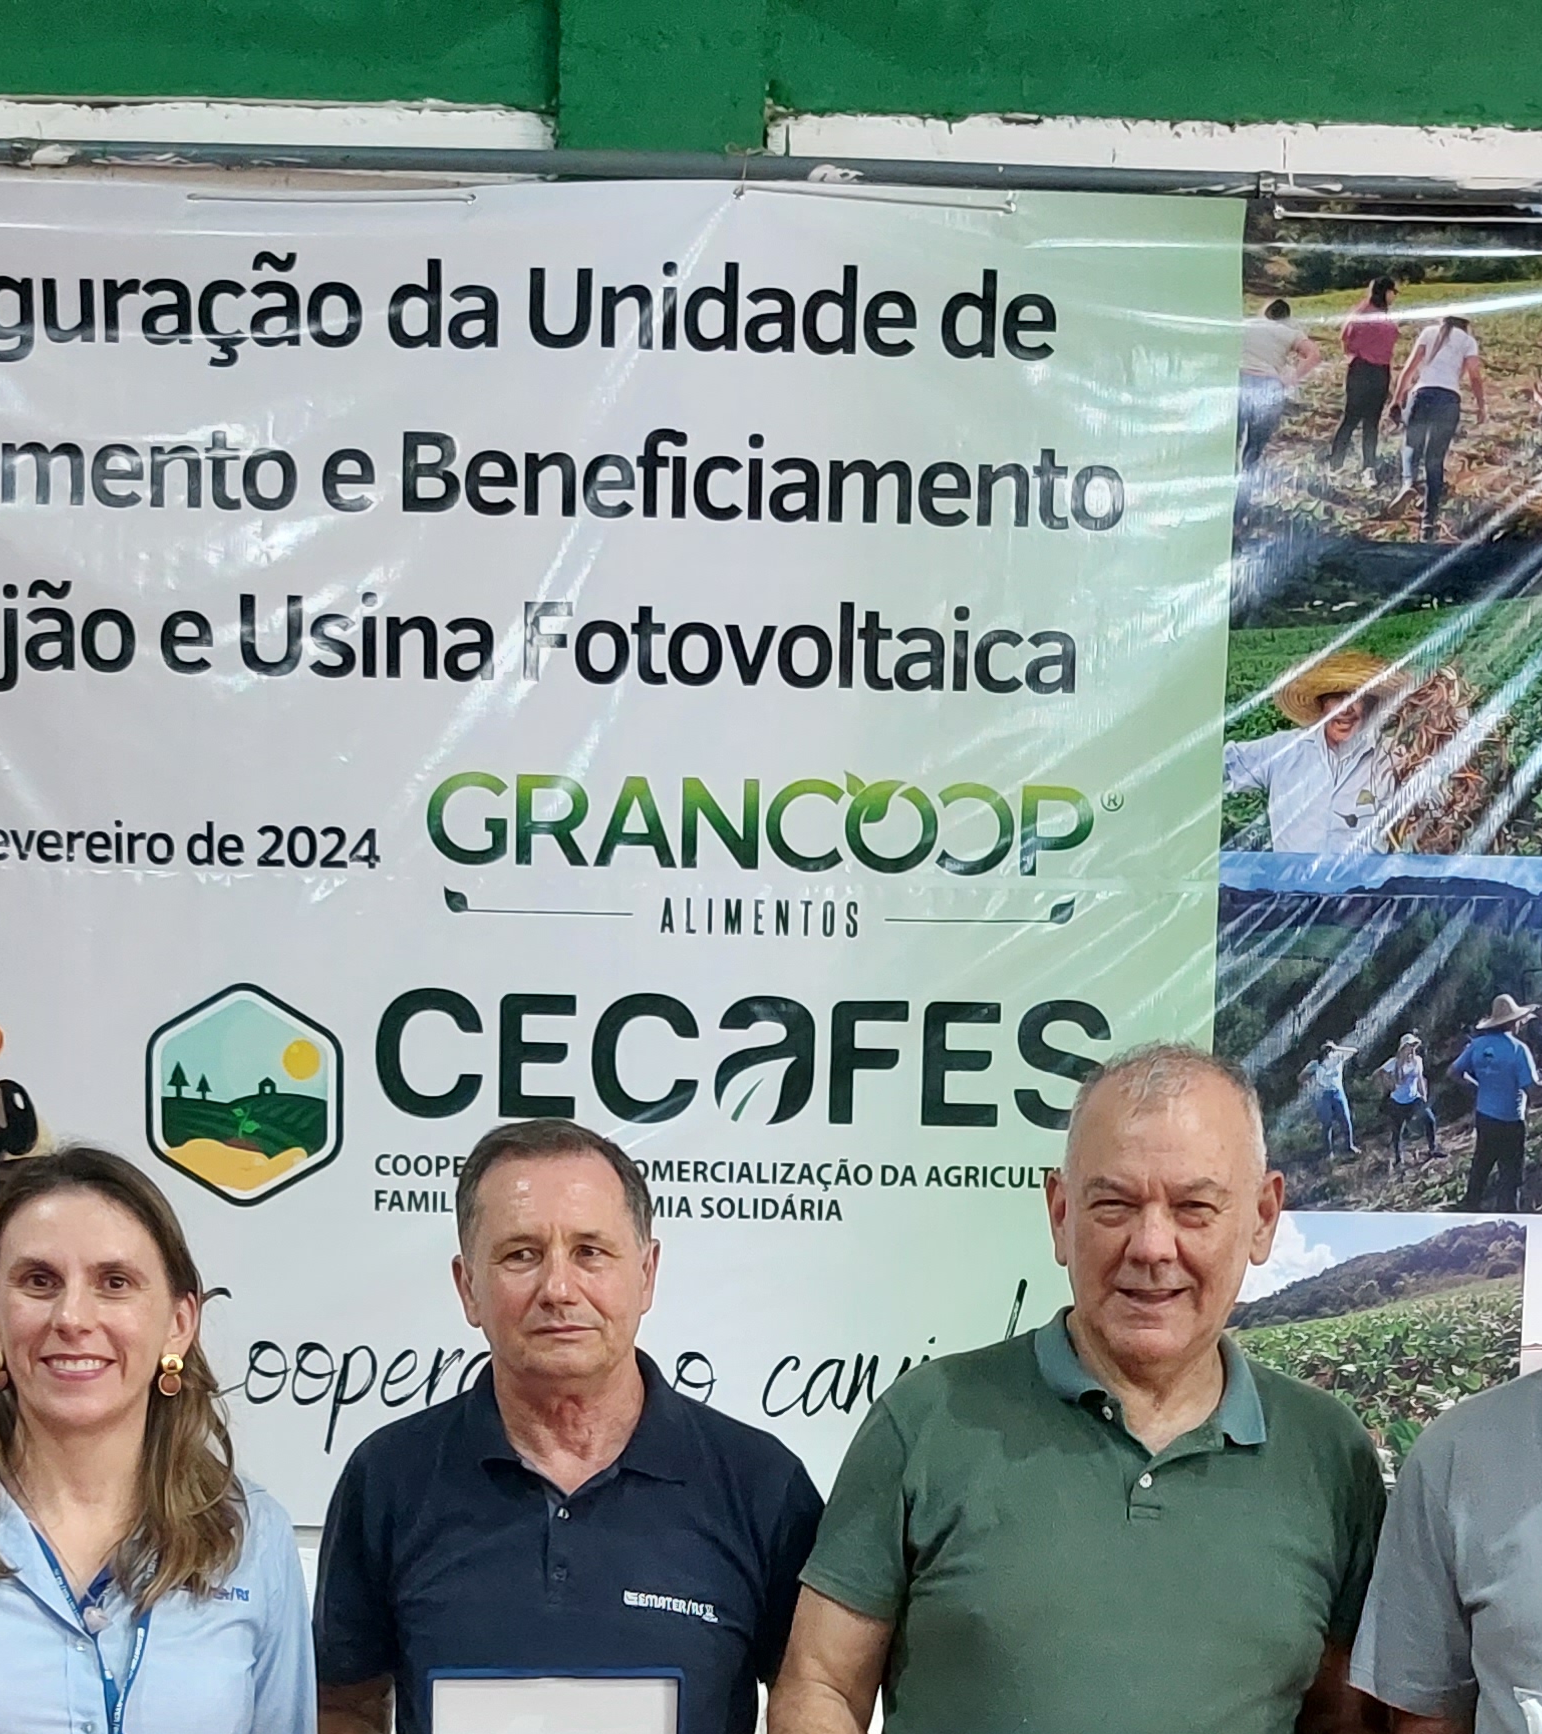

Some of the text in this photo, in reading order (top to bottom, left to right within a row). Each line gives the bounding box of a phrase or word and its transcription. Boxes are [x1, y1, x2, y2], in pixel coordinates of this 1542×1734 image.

[388, 259, 498, 349] da
[529, 261, 915, 355] Unidade
[941, 270, 1056, 360] de
[322, 445, 375, 512] e
[401, 429, 1125, 531] Beneficiamento
[160, 609, 213, 674] e
[239, 592, 495, 681] Usina
[522, 601, 1076, 694] Fotovoltaica
[185, 821, 245, 867] de
[257, 826, 381, 870] 2024
[660, 896, 860, 938] ALIMENTOS
[880, 1165, 917, 1188] DA
[924, 1165, 1061, 1190] AGRICULT
[373, 1189, 454, 1213] FAMIL
[700, 1193, 844, 1223] SOLIDÁRIA
